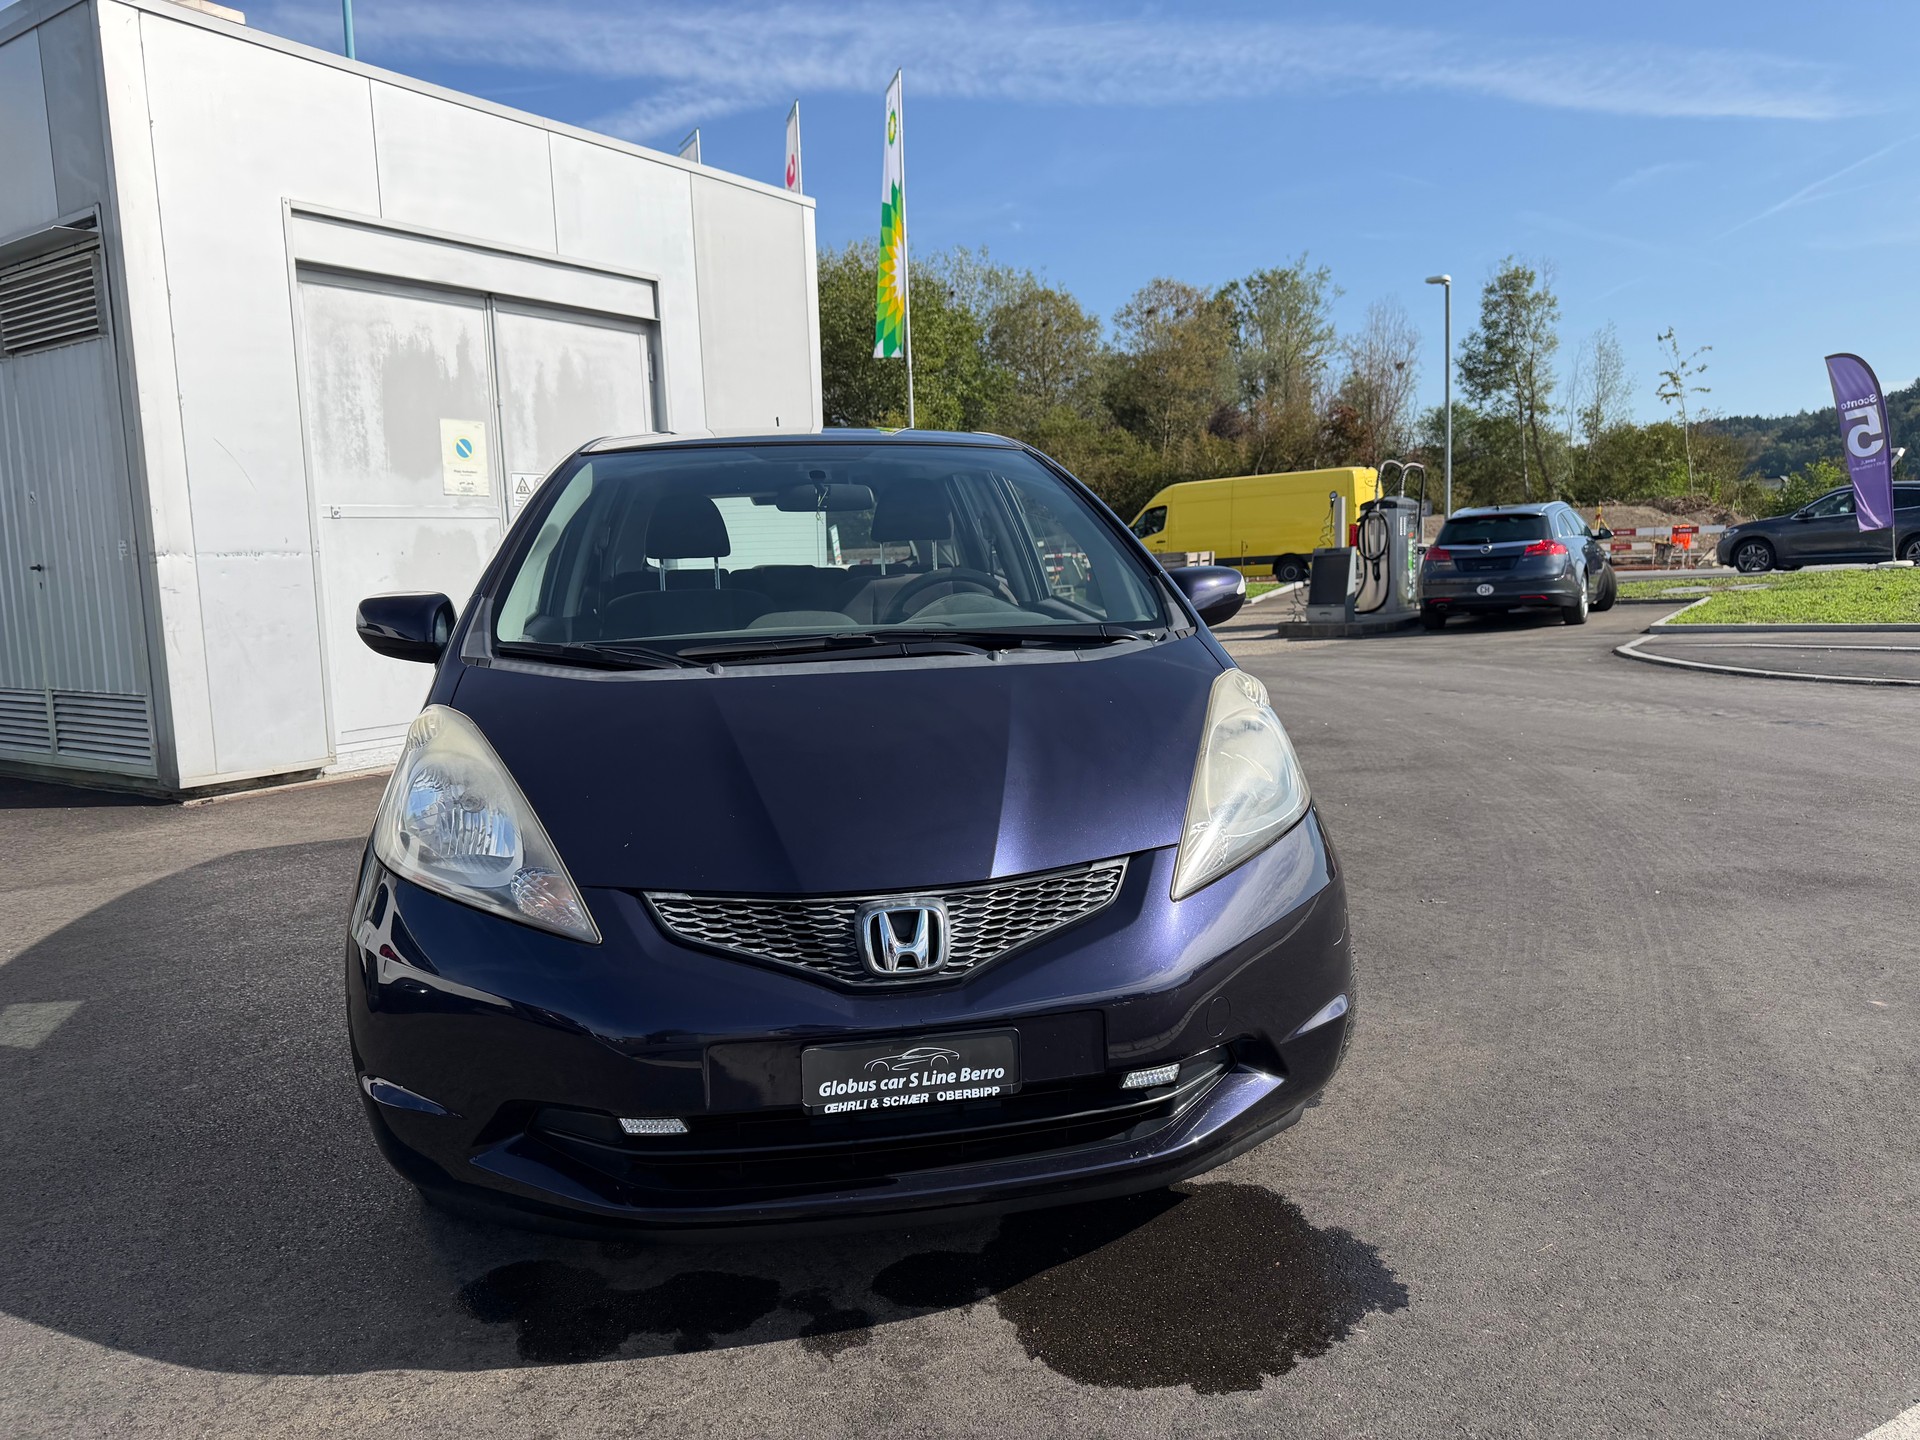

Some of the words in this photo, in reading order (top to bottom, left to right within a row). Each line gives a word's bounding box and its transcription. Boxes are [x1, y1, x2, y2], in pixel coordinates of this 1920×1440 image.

[1479, 585, 1490, 595] CH
[818, 1077, 877, 1097] Globus
[880, 1076, 905, 1090] car
[909, 1072, 919, 1088] S
[921, 1069, 956, 1086] Line
[960, 1067, 1005, 1082] Berro
[870, 1098, 879, 1109] &
[936, 1086, 1001, 1102] OBERBIPP
